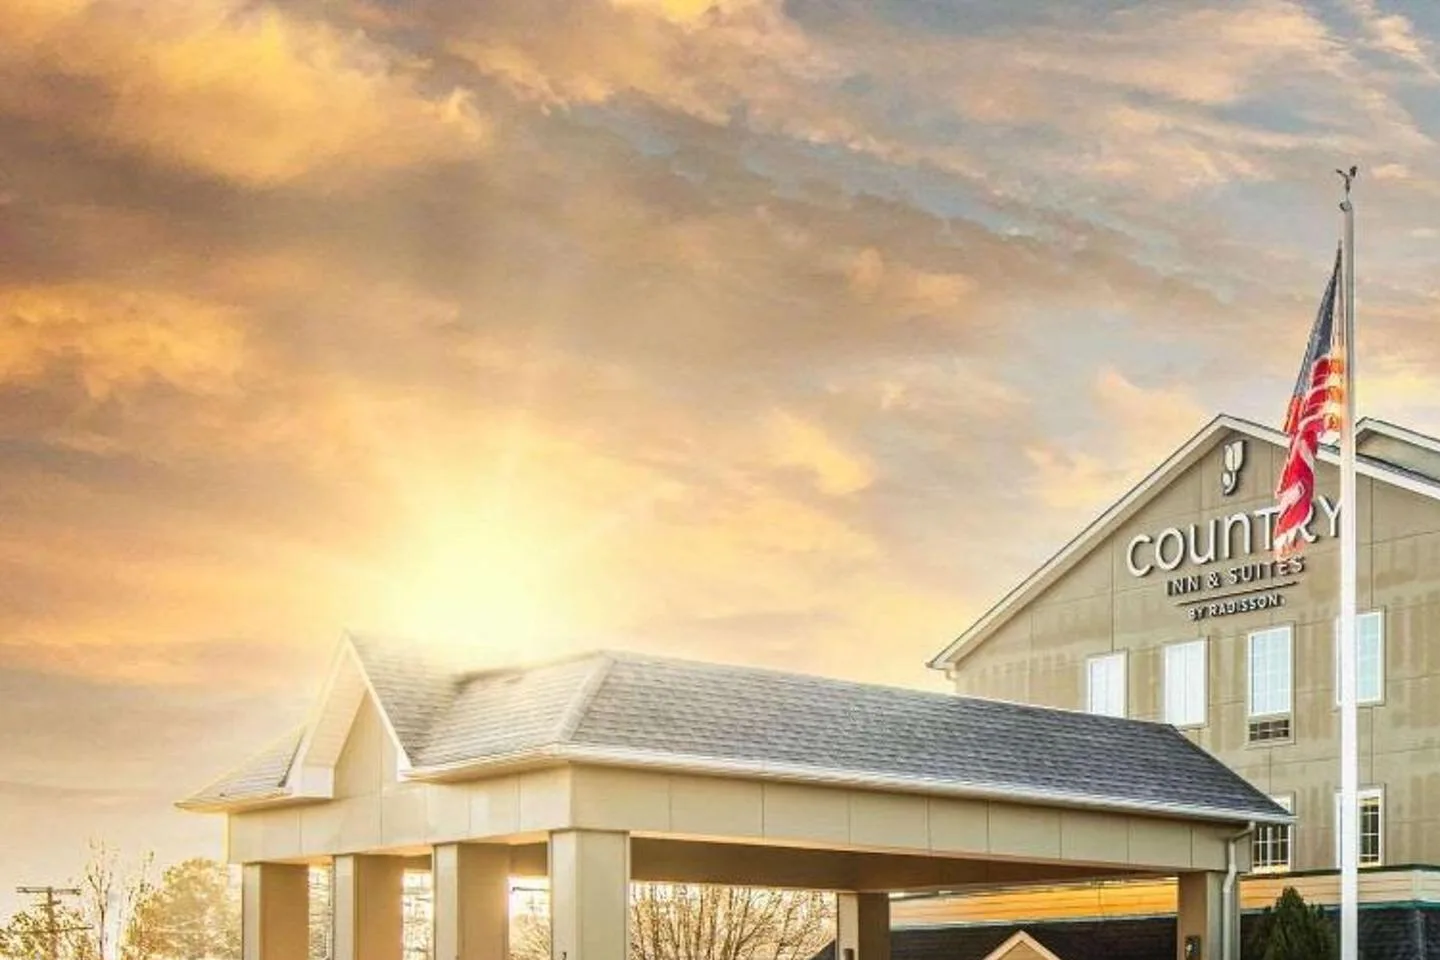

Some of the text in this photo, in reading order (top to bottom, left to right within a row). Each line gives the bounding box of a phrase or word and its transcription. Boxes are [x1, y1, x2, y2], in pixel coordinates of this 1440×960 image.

[1166, 556, 1305, 596] INN & SUITES
[1188, 593, 1282, 621] BY RADISSON
